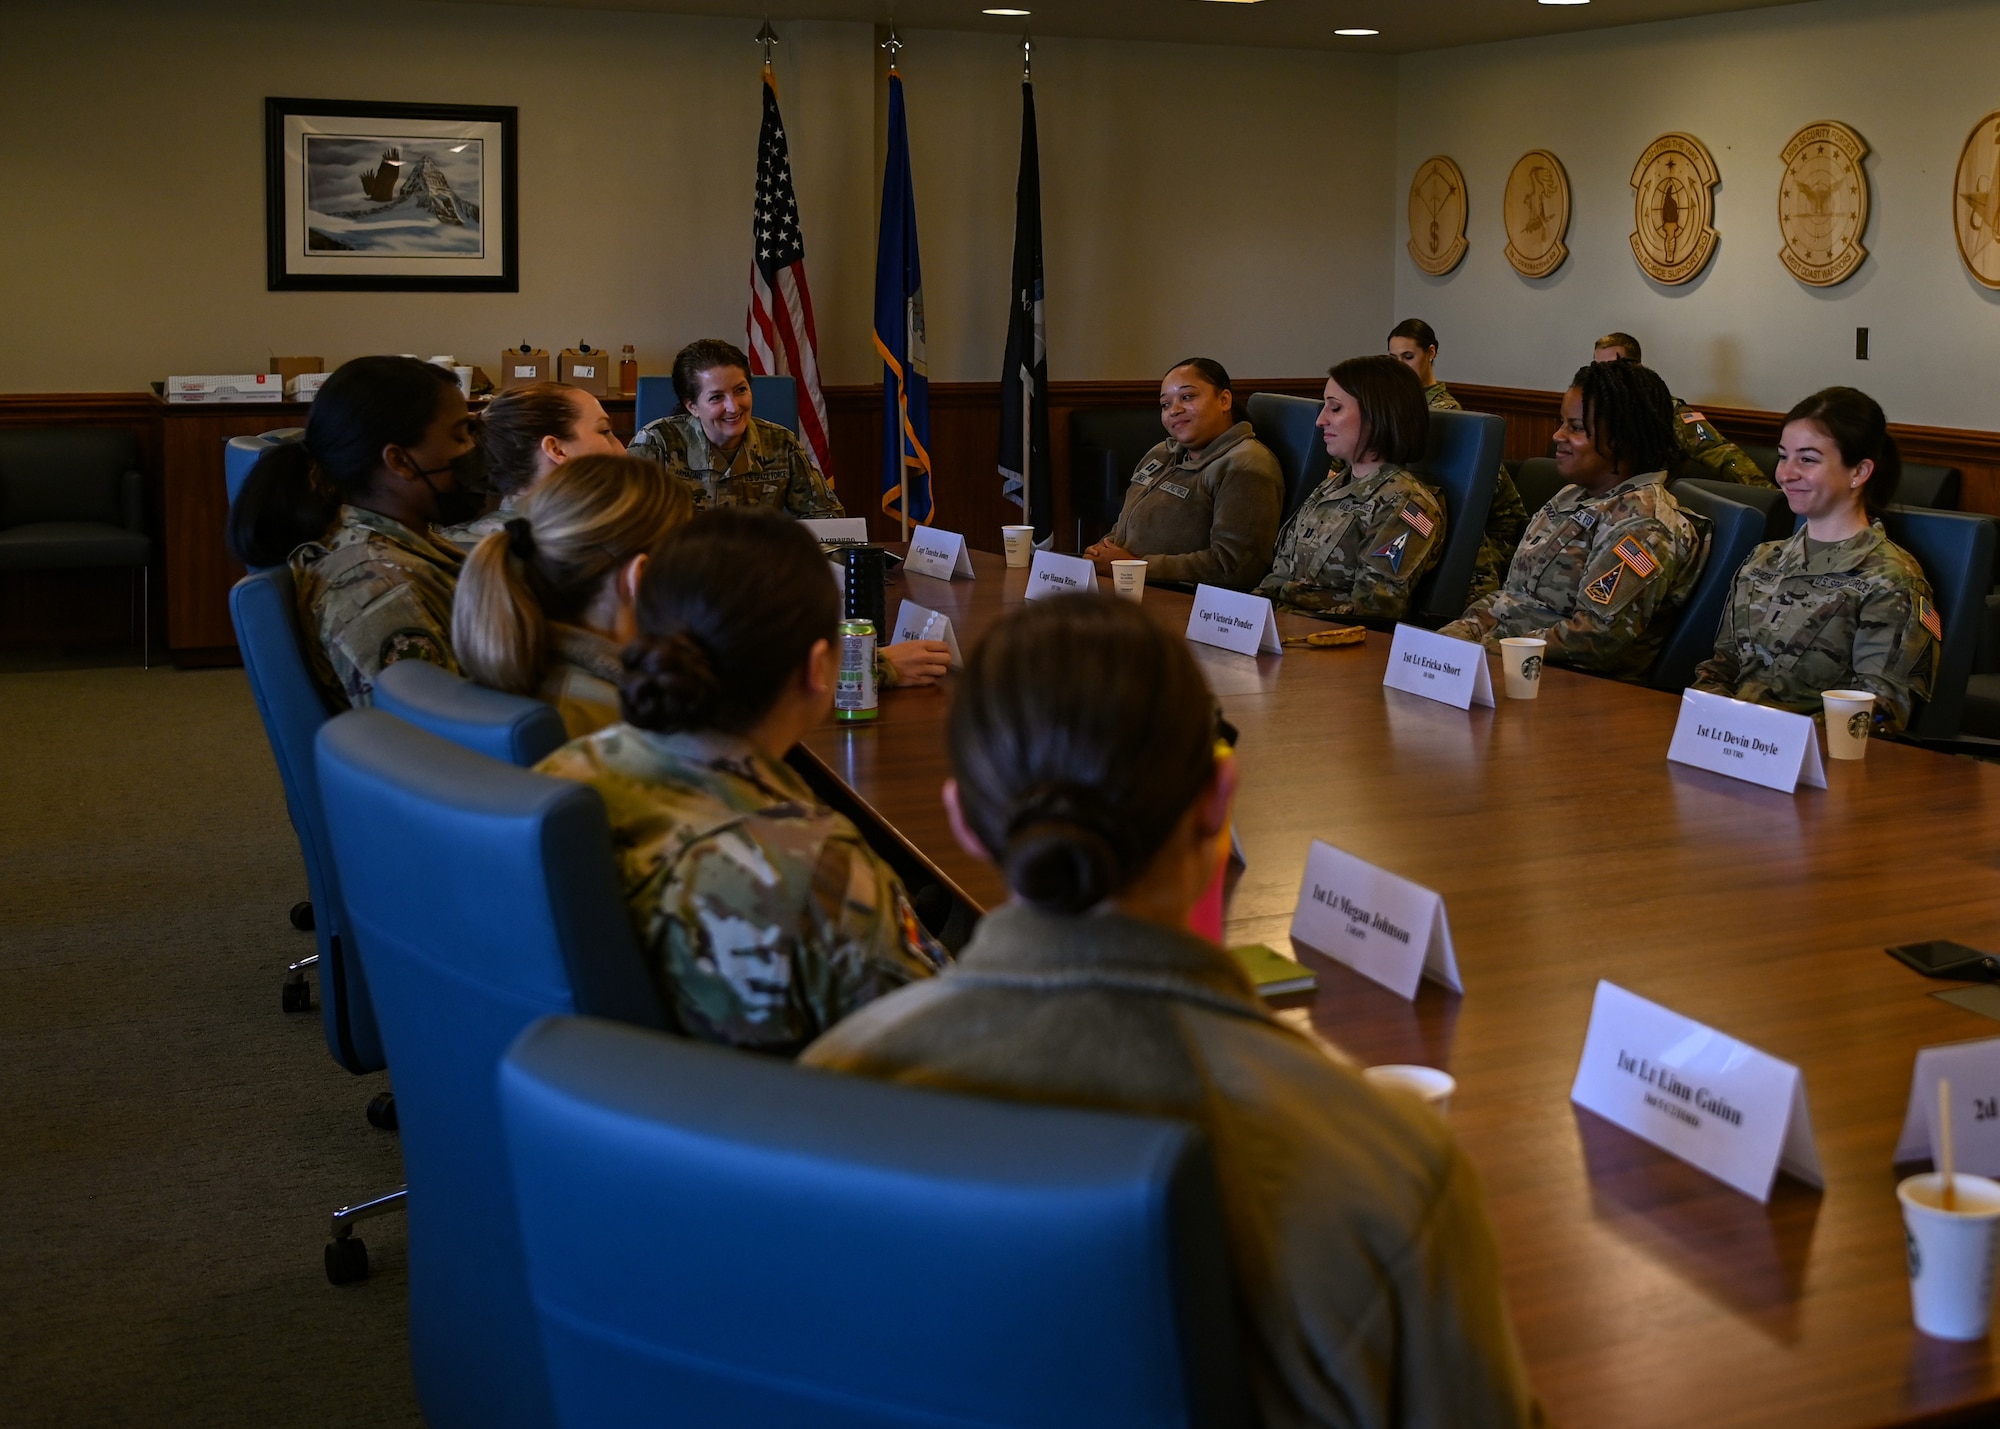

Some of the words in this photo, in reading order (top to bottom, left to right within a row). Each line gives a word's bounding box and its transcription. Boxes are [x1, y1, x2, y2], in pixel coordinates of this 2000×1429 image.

[1642, 140, 1671, 167] LIGHTING
[1671, 141, 1684, 150] THE
[1684, 144, 1699, 161] WAY
[1799, 128, 1831, 145] SECURITY
[1831, 130, 1856, 155] FORCES
[1644, 256, 1667, 276] FORCE
[1667, 254, 1699, 278] SUPPORT
[1785, 253, 1800, 272] WEST
[1800, 264, 1821, 280] COAST
[1821, 253, 1852, 279] WARRIORS
[675, 468, 703, 481] ARMAGNO
[1039, 570, 1050, 583] Capt
[1751, 568, 1779, 582] SHORT
[1199, 608, 1213, 622] Capt
[1213, 611, 1233, 626] Victoria
[1233, 617, 1254, 630] Ponder
[1403, 652, 1412, 664] 1st
[1412, 654, 1421, 665] Lt
[1421, 657, 1442, 671] Ericka
[1442, 662, 1461, 677] Short
[1696, 724, 1710, 738] 1st
[1710, 728, 1722, 741] Lt
[1723, 731, 1750, 748] Devin
[1751, 738, 1779, 756] Doyle
[1312, 883, 1326, 902] 1st
[1325, 890, 1339, 908] Lt
[1339, 895, 1371, 924] Megan
[1371, 912, 1411, 945] Johnson
[1617, 1048, 1637, 1074] 1st
[1637, 1059, 1658, 1083] Lt
[1693, 1086, 1744, 1128] Guinn
[1974, 1095, 1999, 1121] 2d
